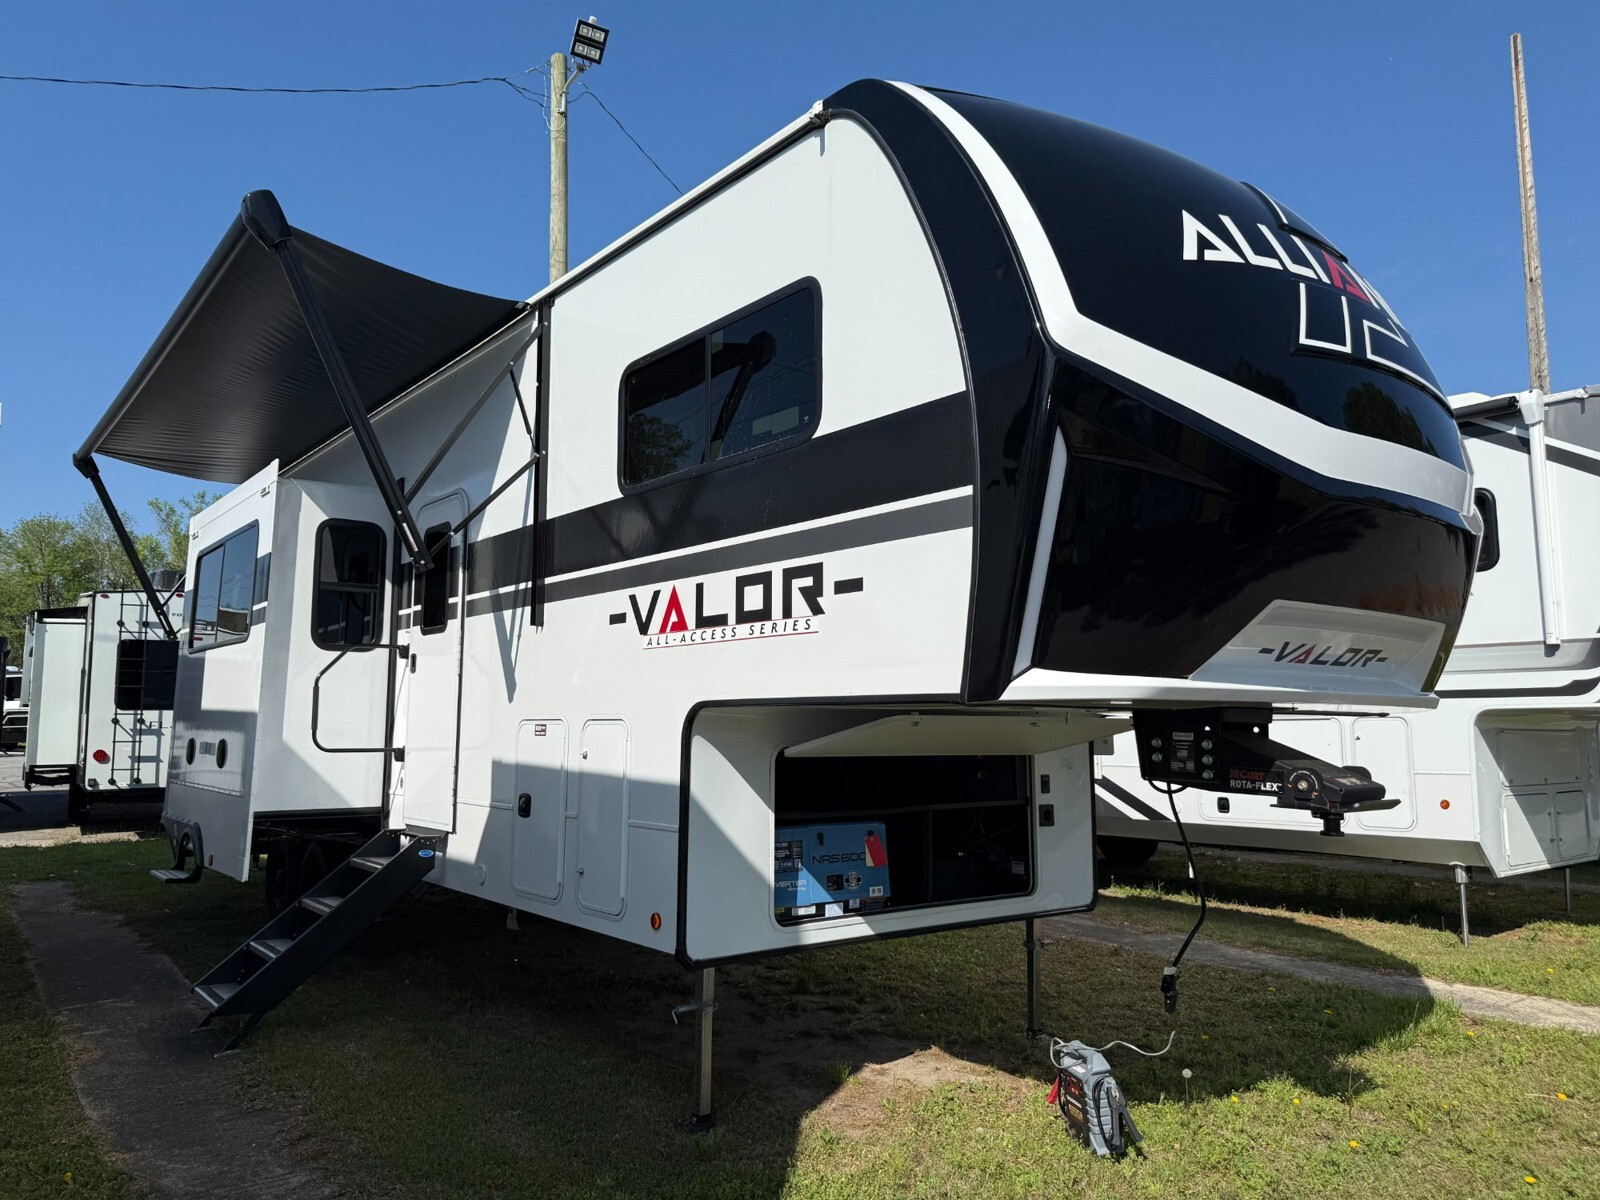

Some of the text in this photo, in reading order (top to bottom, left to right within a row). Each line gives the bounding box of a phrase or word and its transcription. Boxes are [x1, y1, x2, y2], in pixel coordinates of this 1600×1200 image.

[647, 618, 812, 646] ALL-ACCESS SERIES
[1229, 779, 1279, 792] ROTA-FLEX
